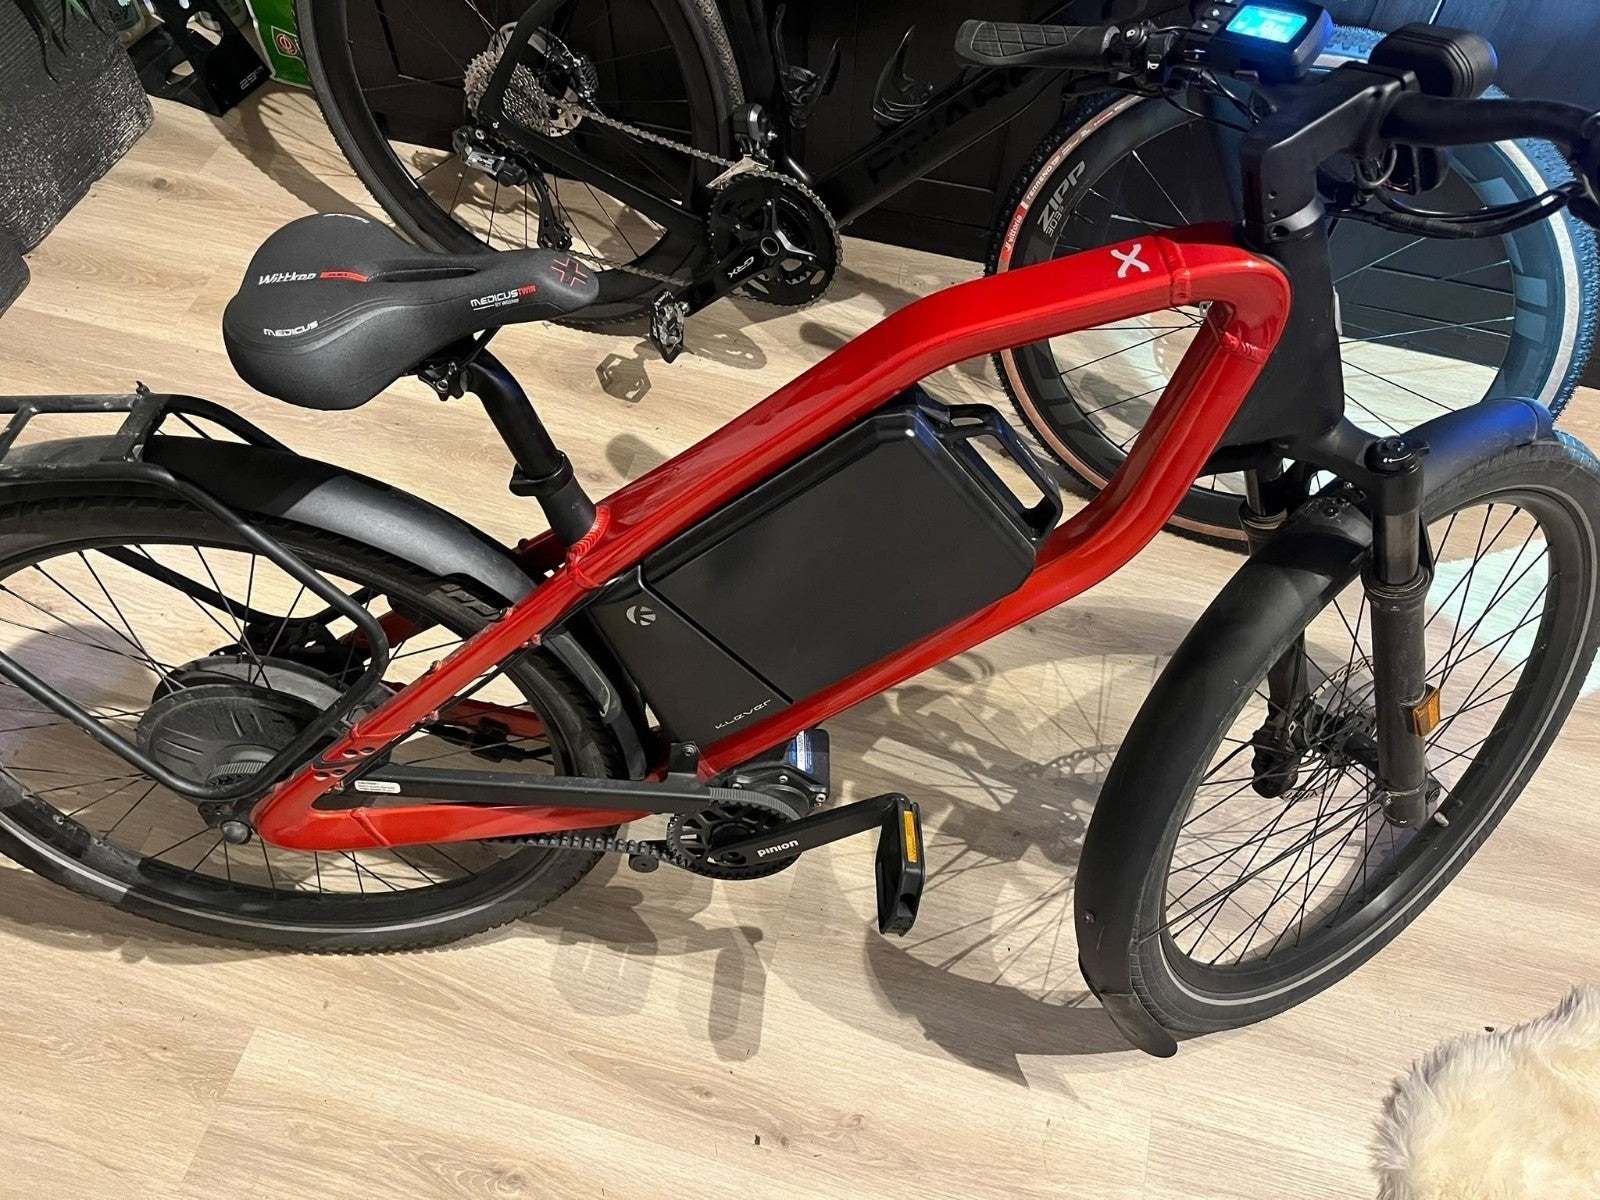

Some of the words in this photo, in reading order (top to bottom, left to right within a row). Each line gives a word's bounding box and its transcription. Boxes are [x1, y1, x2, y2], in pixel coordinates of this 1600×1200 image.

[1037, 160, 1086, 232] ZIPP
[728, 256, 754, 278] GRX
[258, 271, 317, 285] Wittkop
[263, 320, 319, 337] MEDICUS
[757, 839, 799, 858] pinion
